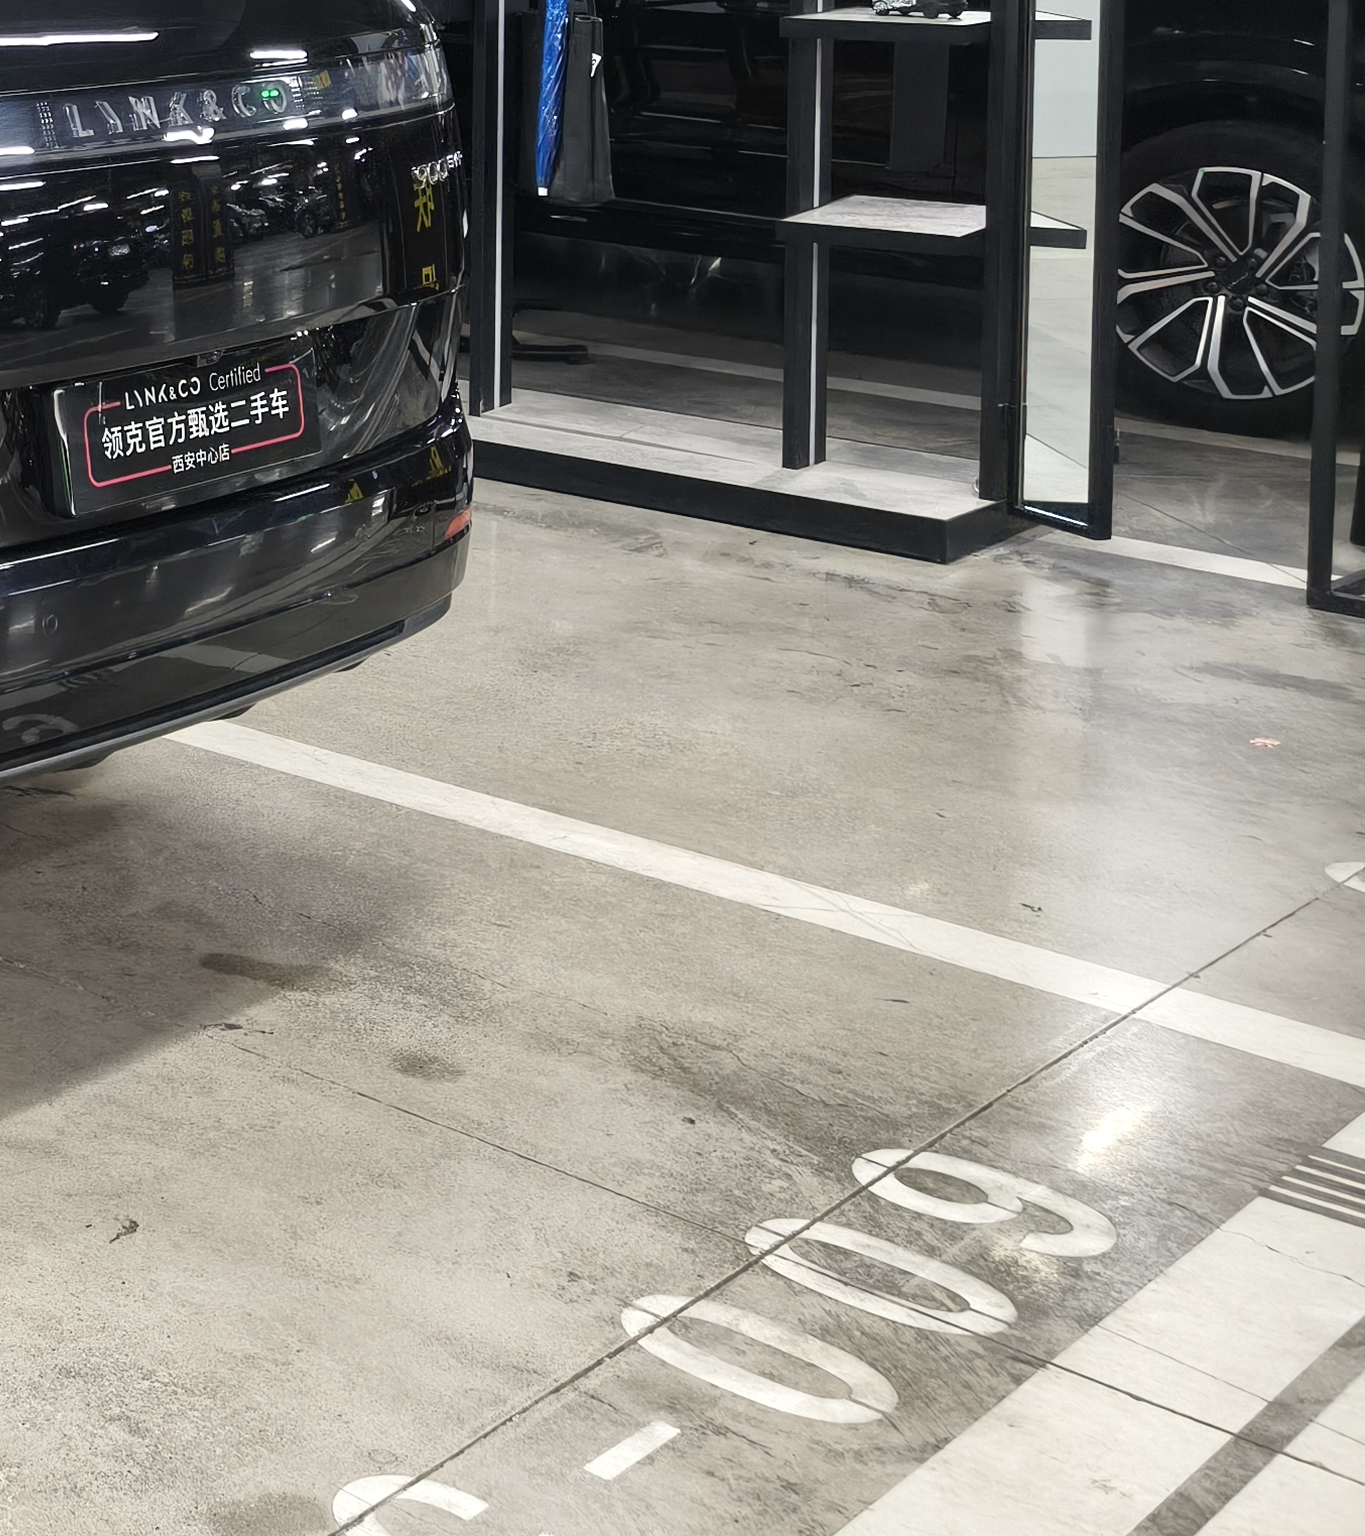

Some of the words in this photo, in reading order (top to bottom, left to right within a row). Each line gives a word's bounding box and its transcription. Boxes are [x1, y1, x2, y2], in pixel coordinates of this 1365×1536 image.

[63, 79, 288, 138] LYNK&CO
[125, 376, 201, 410] LYNK&CO
[209, 363, 262, 392] Certified
[102, 387, 290, 460] 领克官方甄选二手车
[172, 443, 231, 474] 西安中心店
